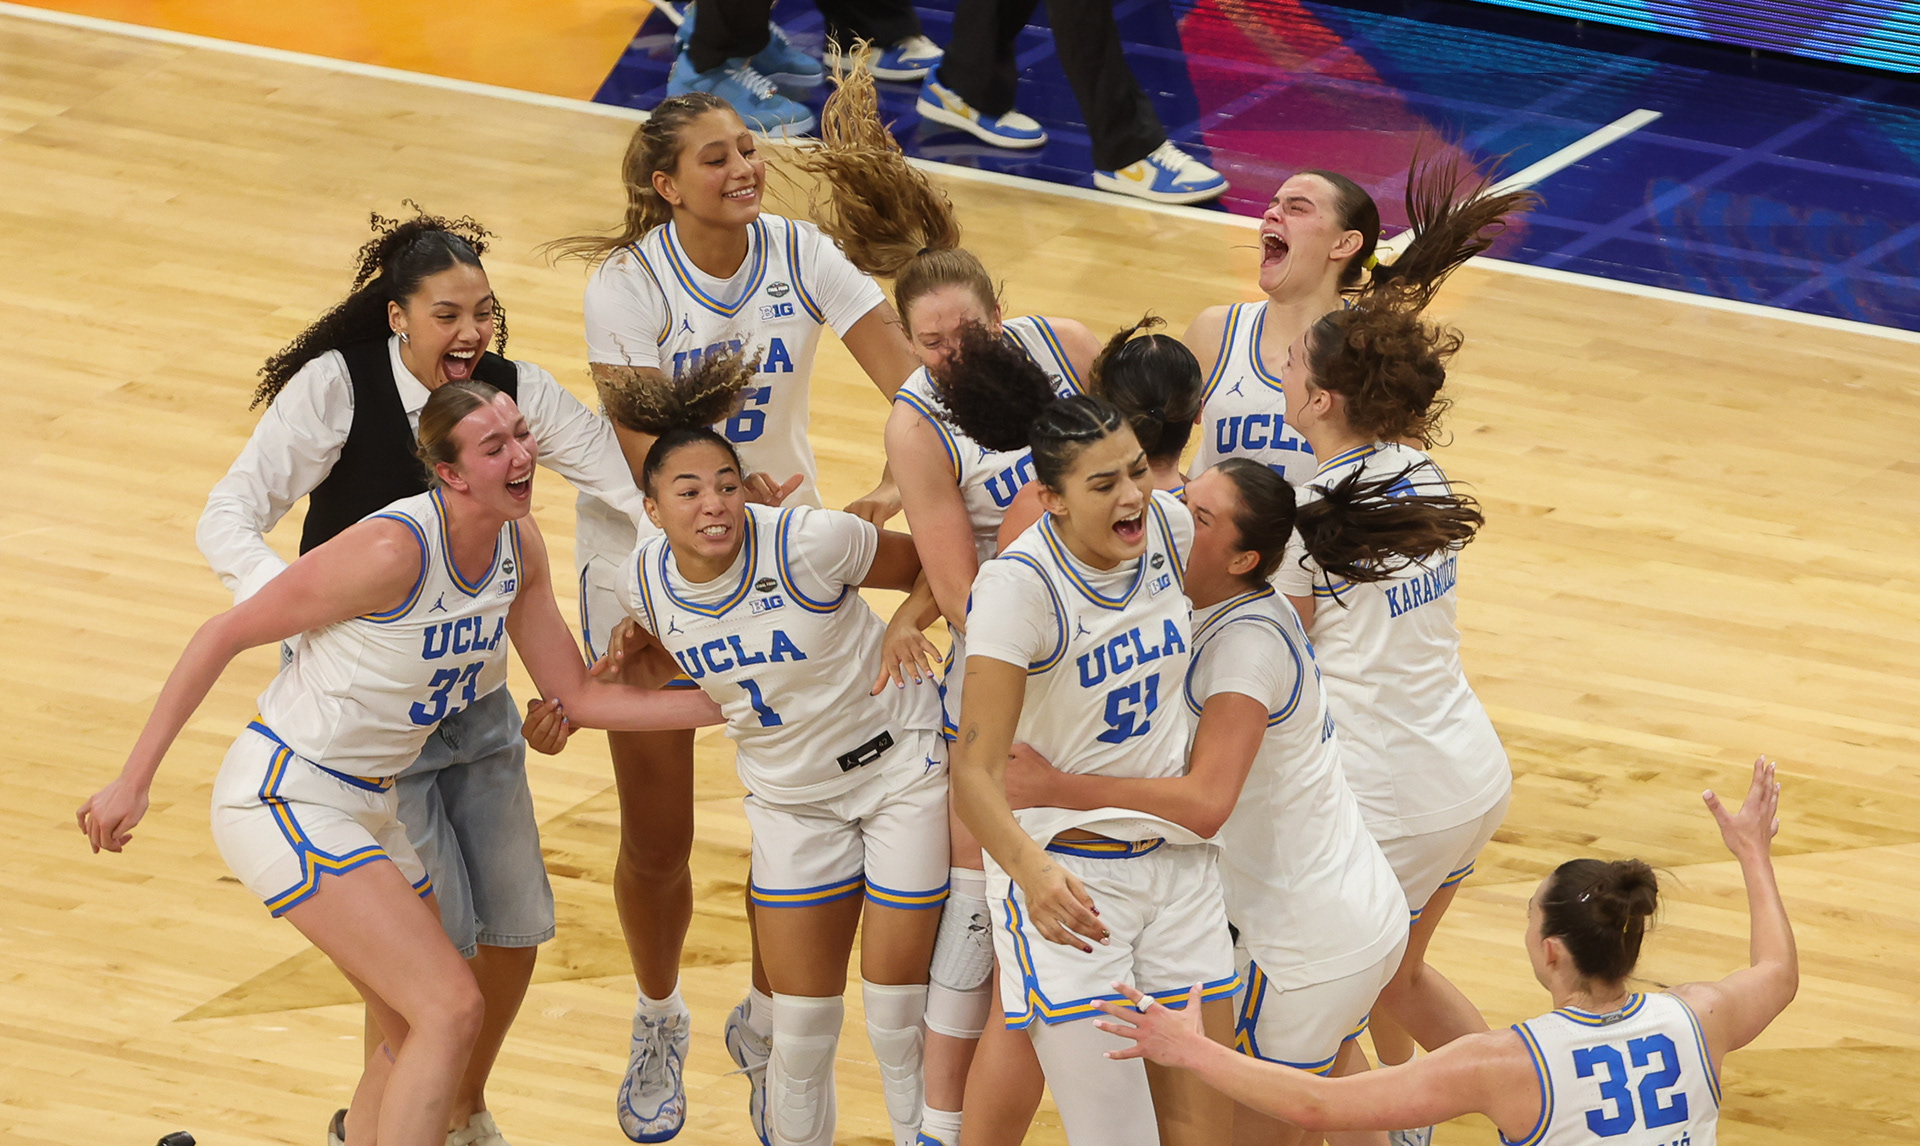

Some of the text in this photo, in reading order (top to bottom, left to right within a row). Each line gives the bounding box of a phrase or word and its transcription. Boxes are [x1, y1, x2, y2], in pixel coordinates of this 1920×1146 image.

[759, 302, 794, 320] BIG
[1216, 413, 1315, 454] UCL
[749, 595, 785, 614] BIG
[422, 616, 504, 660] UCLA
[675, 630, 808, 679] UCLA
[1076, 619, 1185, 688] UCLA
[410, 661, 484, 725] 33
[736, 679, 783, 727] 1
[1096, 673, 1160, 744] 51
[1572, 1033, 1688, 1137] 32
